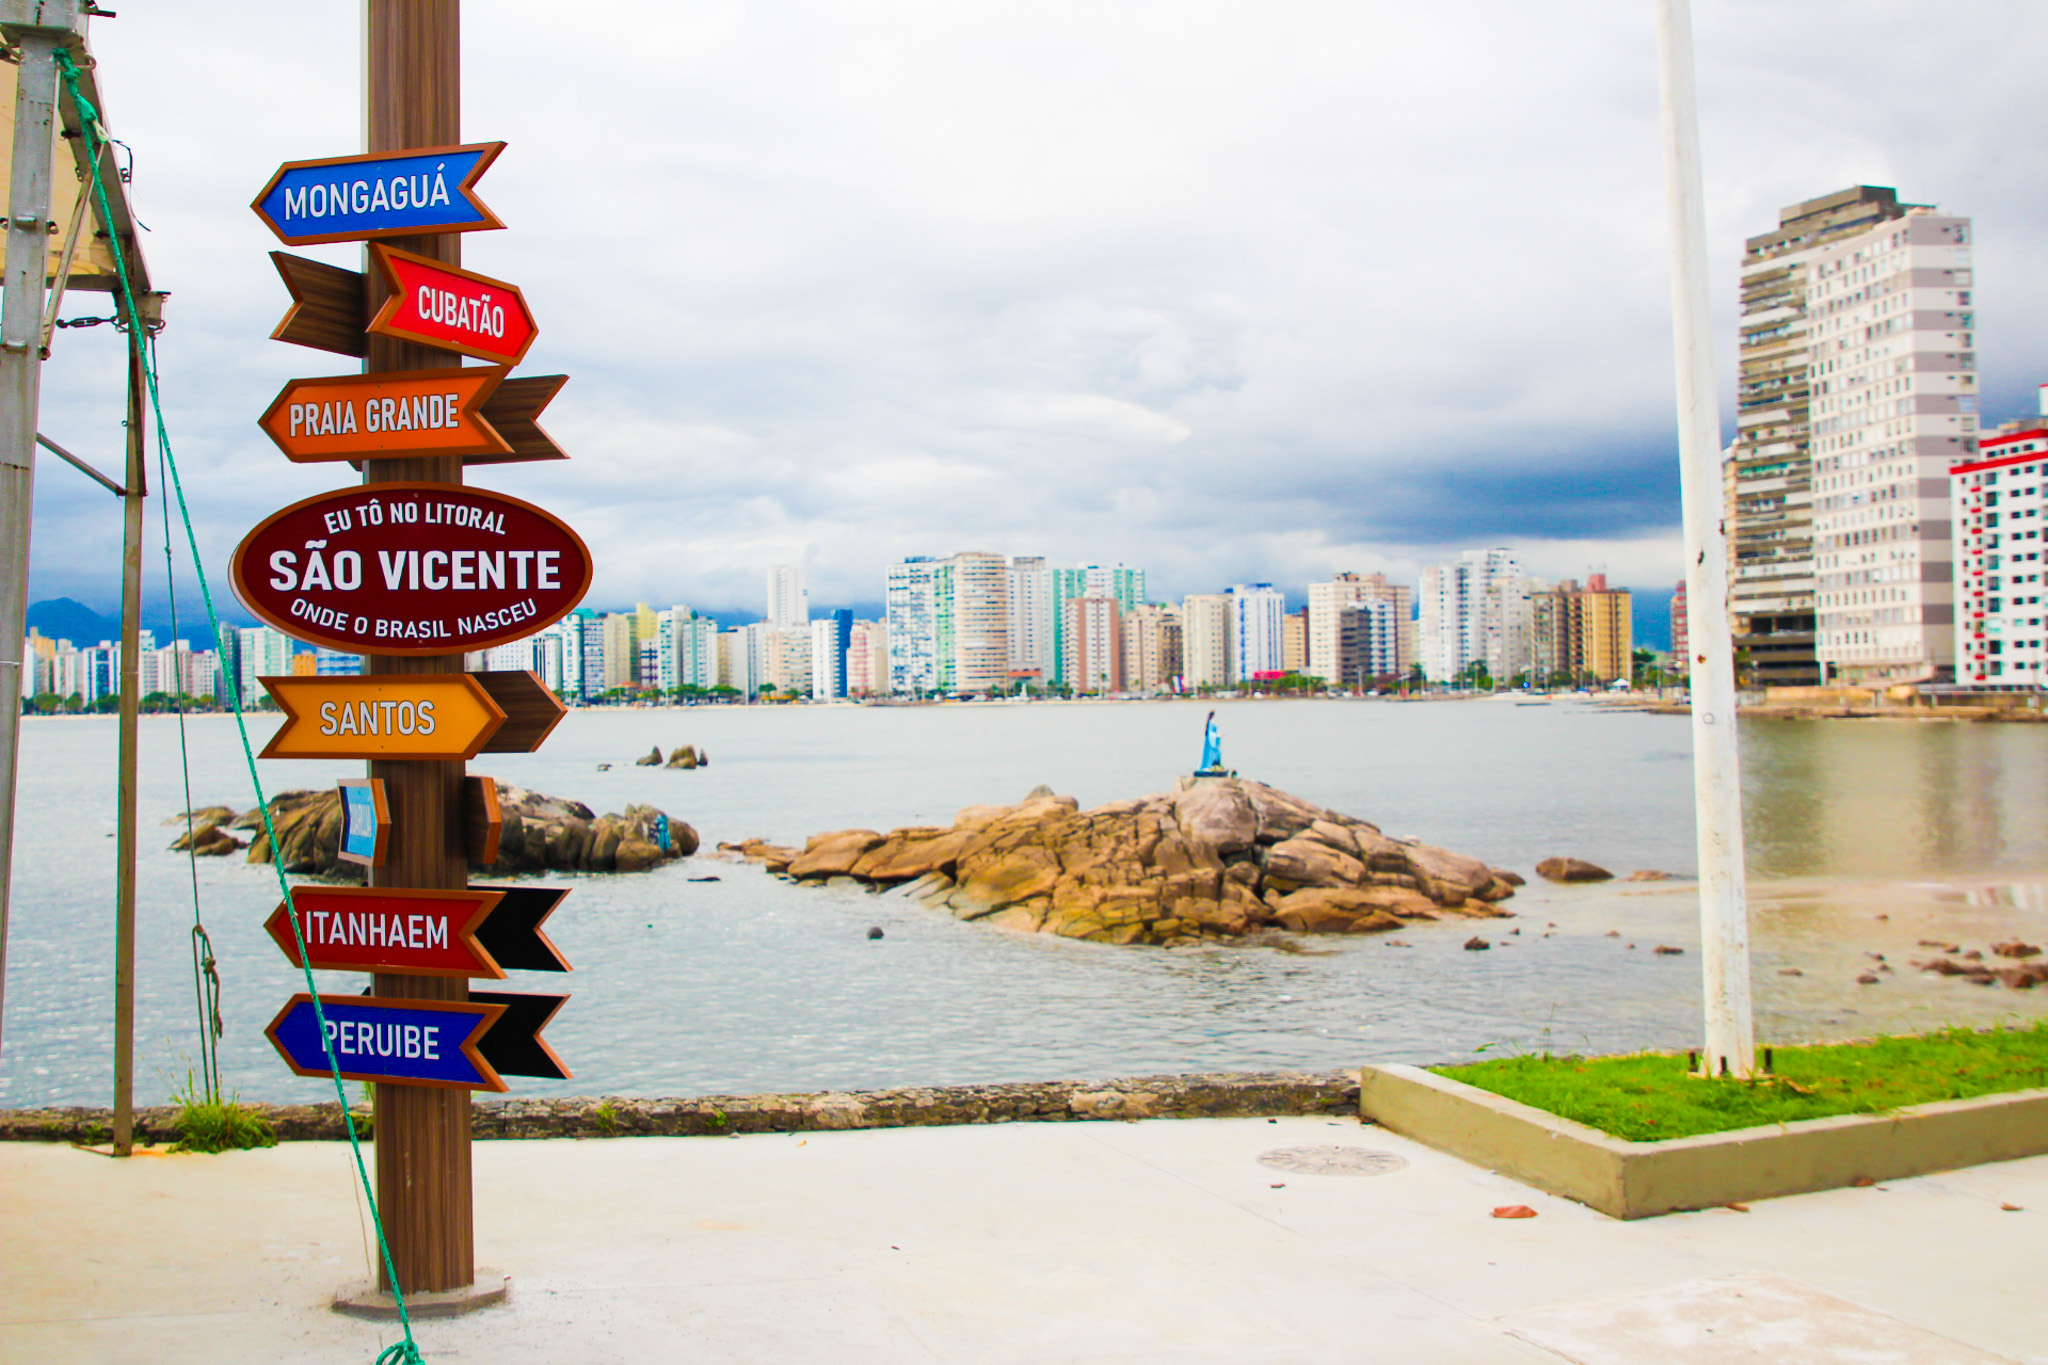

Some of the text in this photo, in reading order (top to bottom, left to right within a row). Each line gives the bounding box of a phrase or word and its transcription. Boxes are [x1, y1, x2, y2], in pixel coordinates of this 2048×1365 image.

[285, 163, 450, 220] MONGAGUÁ
[418, 286, 505, 338] CUBATÃO
[290, 394, 459, 437] PRAIA GRANDE
[324, 499, 506, 535] EU TÔ NO LITORAL
[269, 540, 561, 591] SÃO VICENTE
[290, 598, 537, 639] ONDE O BRASIL NASCEU
[320, 700, 436, 736] SANTOS
[306, 911, 448, 950] ITANHAEM
[321, 1020, 440, 1060] PERUIBE
